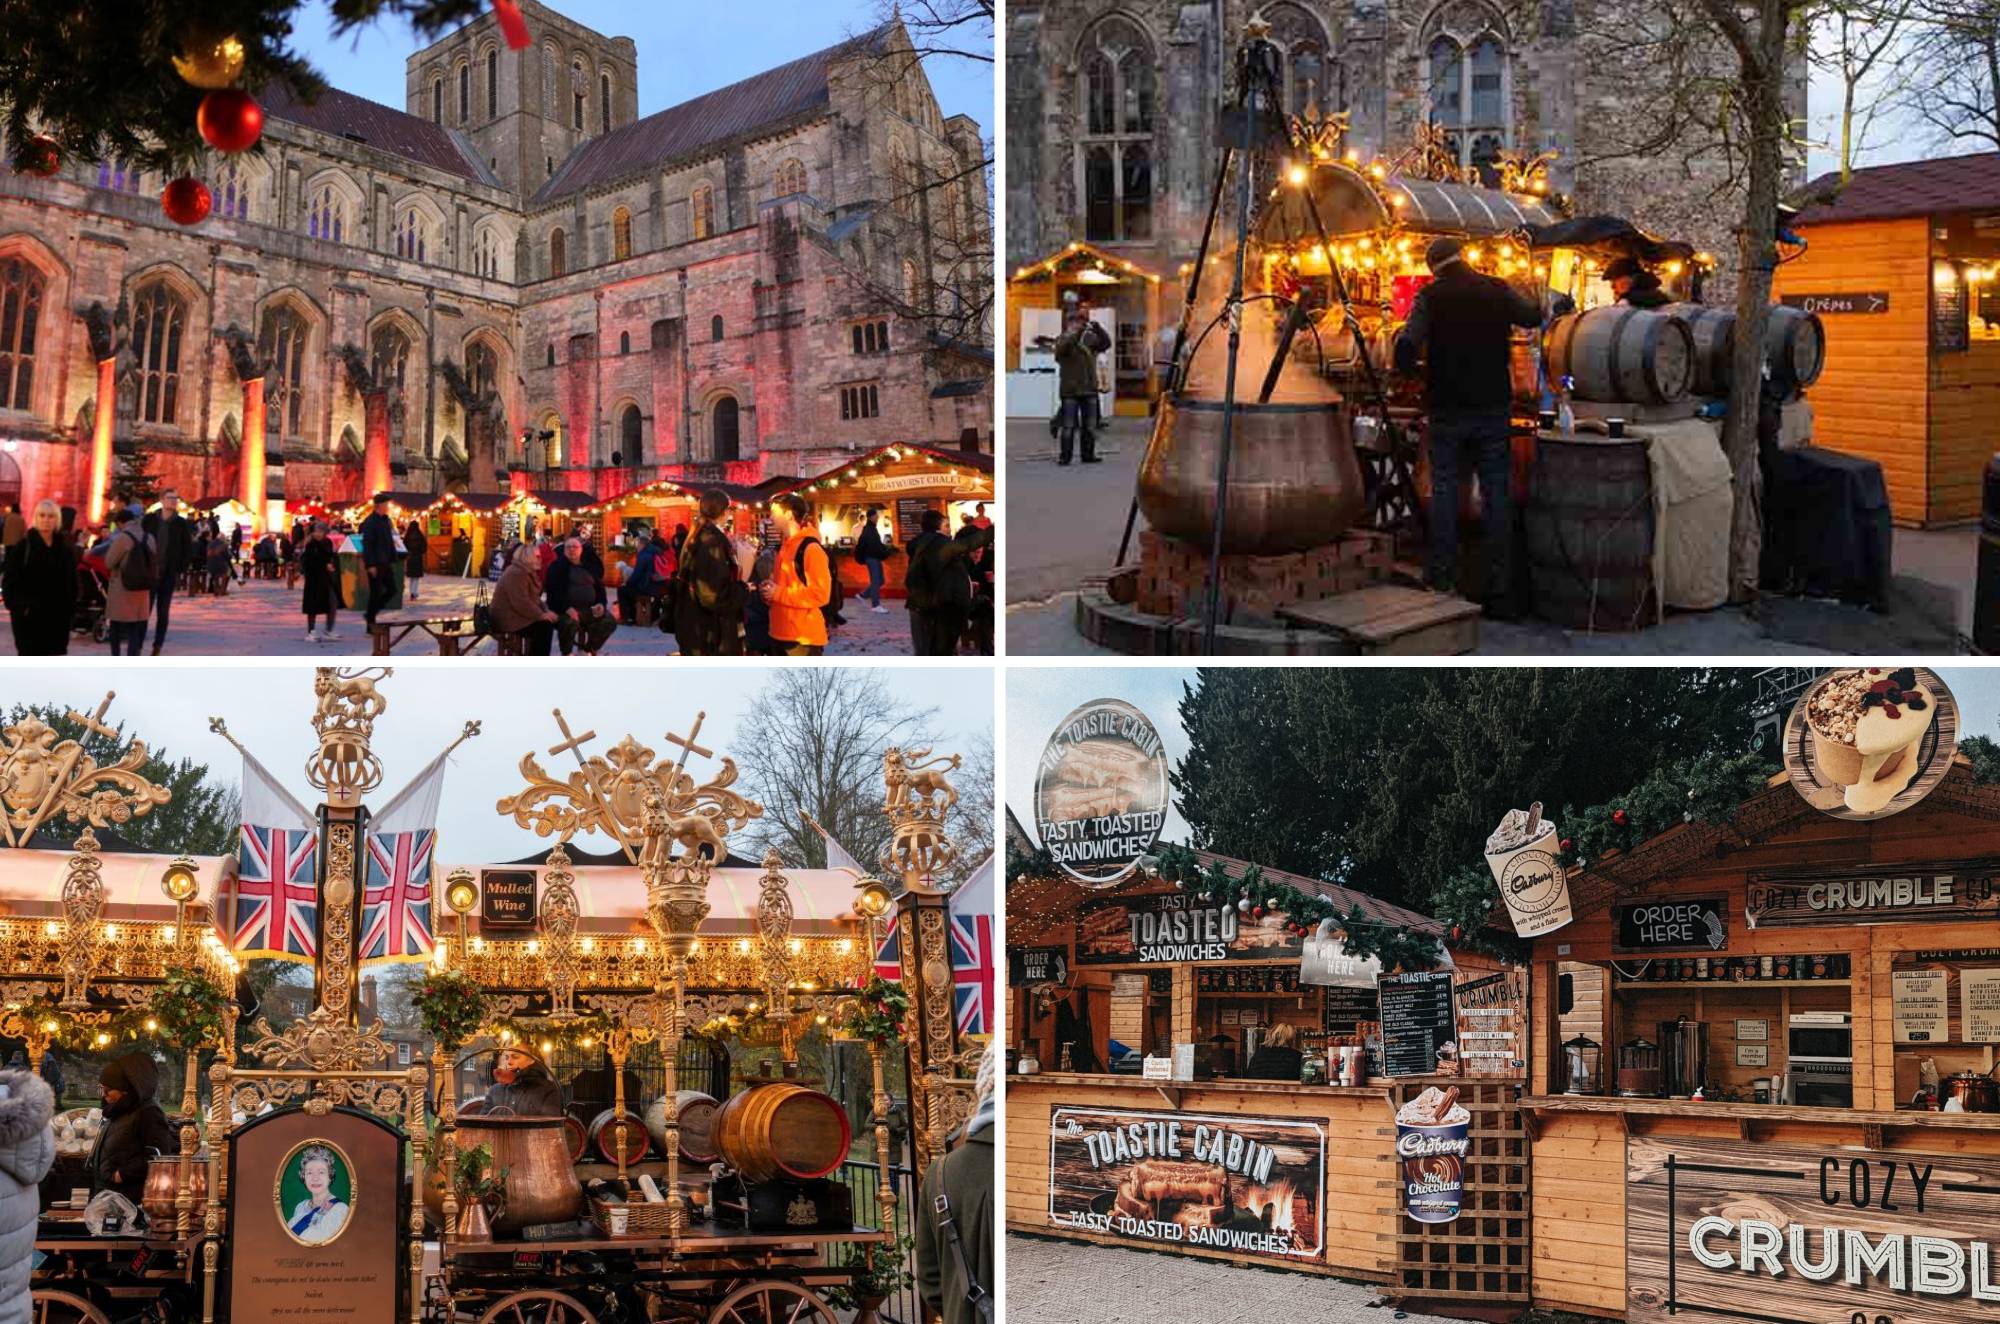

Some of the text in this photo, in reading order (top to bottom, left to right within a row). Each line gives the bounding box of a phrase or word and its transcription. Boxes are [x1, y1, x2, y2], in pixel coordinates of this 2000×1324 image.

[1041, 712, 1162, 770] THE TOASTIE CABIN
[1094, 811, 1162, 838] TOASTED
[1052, 834, 1150, 863] SANDWICHES
[486, 883, 533, 894] Mulled
[1510, 871, 1554, 894] Cadbury
[1754, 887, 1800, 909] COZY
[1806, 875, 1954, 911] CRUMBLE
[493, 899, 526, 911] Wine
[1160, 895, 1197, 910] TASTY
[1515, 905, 1569, 926] with whipped cream
[1633, 904, 1701, 926] ORDER
[1128, 908, 1236, 945] TOASTED
[1640, 924, 1694, 943] HERE
[1024, 952, 1049, 965] ORDER
[1139, 943, 1226, 962] SANDWICHES
[1026, 965, 1046, 979] HERE
[1328, 960, 1354, 976] HERE
[1399, 971, 1431, 984] TOASTIE
[1460, 981, 1523, 1009] CRUMBLE
[1065, 1118, 1084, 1136] The
[1083, 1121, 1275, 1185] TOASTIE CABIN
[1399, 1132, 1469, 1158] Cadbury
[1408, 1181, 1461, 1195] Chocolate
[1423, 1172, 1441, 1183] Hot
[1819, 1156, 1933, 1213] COZY
[1069, 1210, 1289, 1255] TASTY TOASTED SANDWICHES
[1688, 1215, 2000, 1300] CRUMBL
